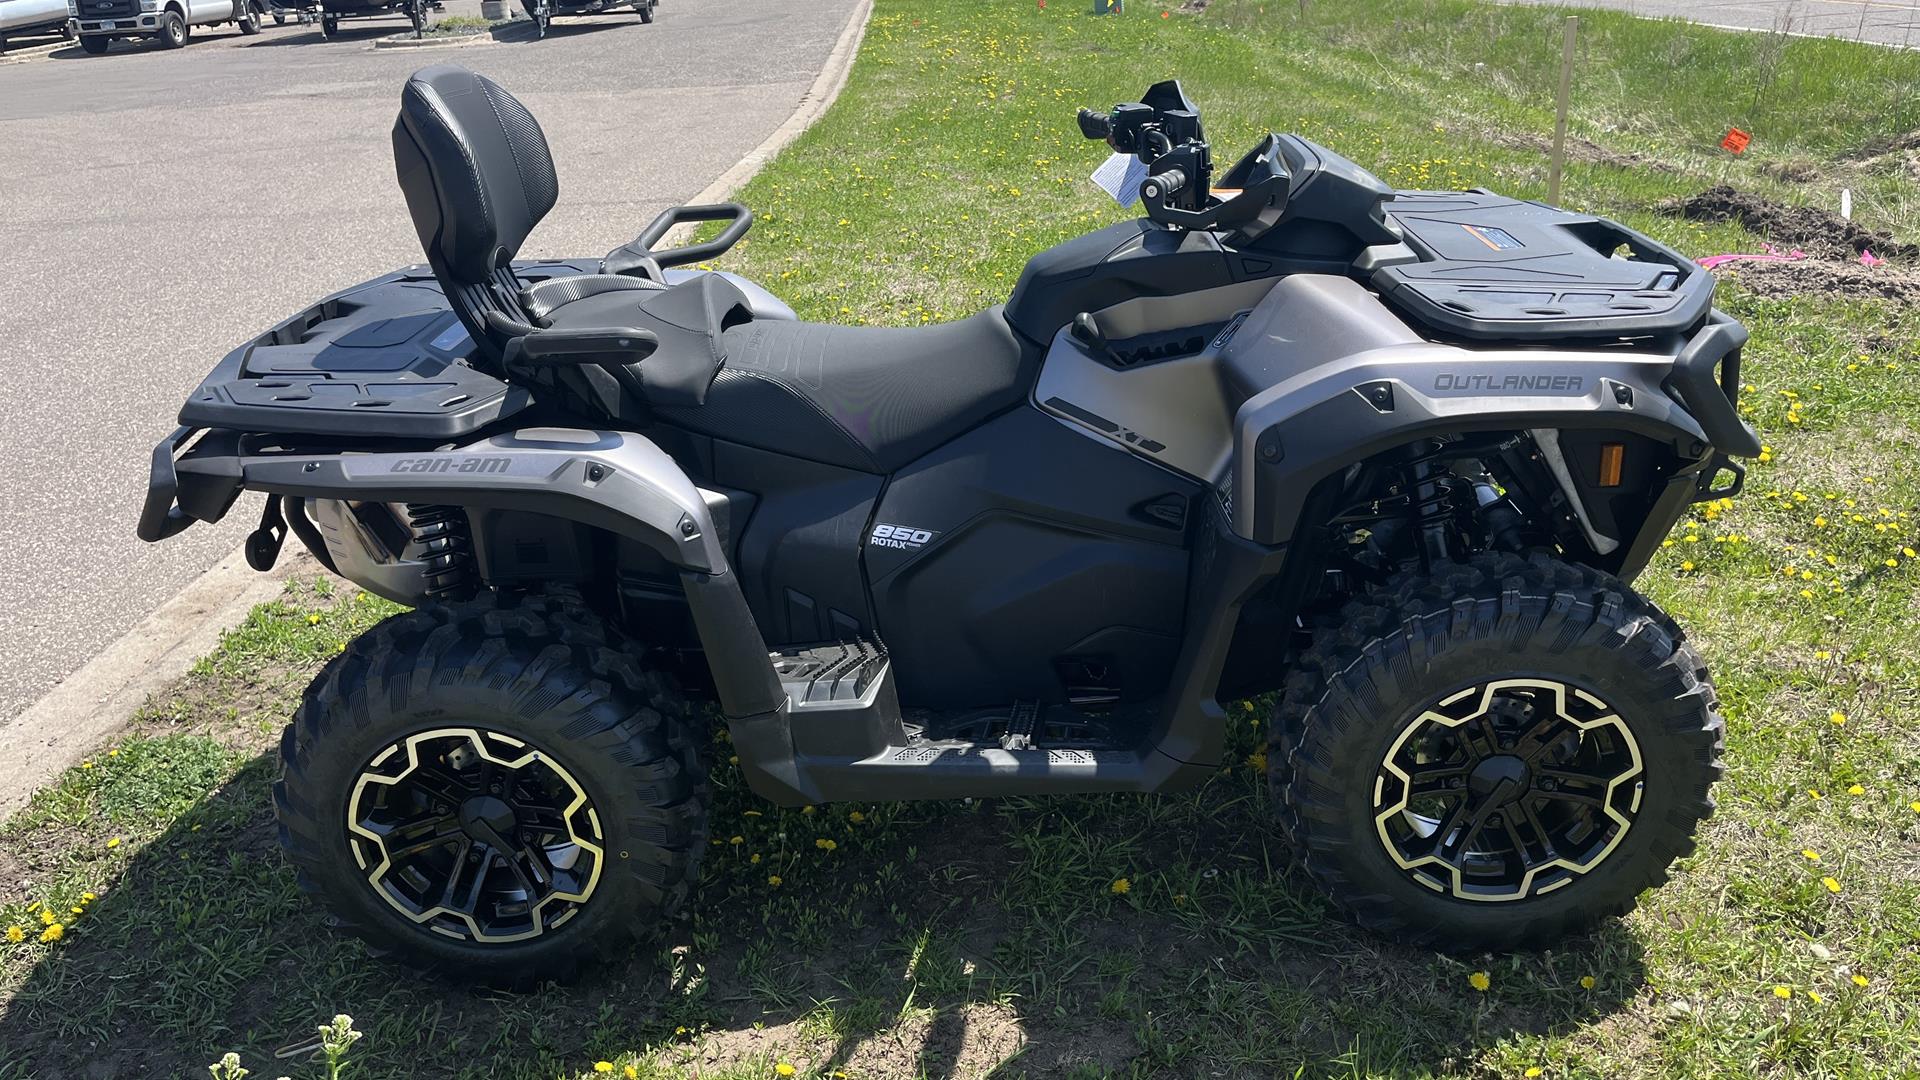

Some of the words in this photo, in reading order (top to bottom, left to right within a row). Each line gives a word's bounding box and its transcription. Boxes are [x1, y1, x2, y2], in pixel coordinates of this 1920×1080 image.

[1434, 374, 1583, 391] OUTLANDER
[1111, 425, 1152, 446] XT
[873, 524, 932, 544] 850
[871, 537, 906, 550] ROTAX
